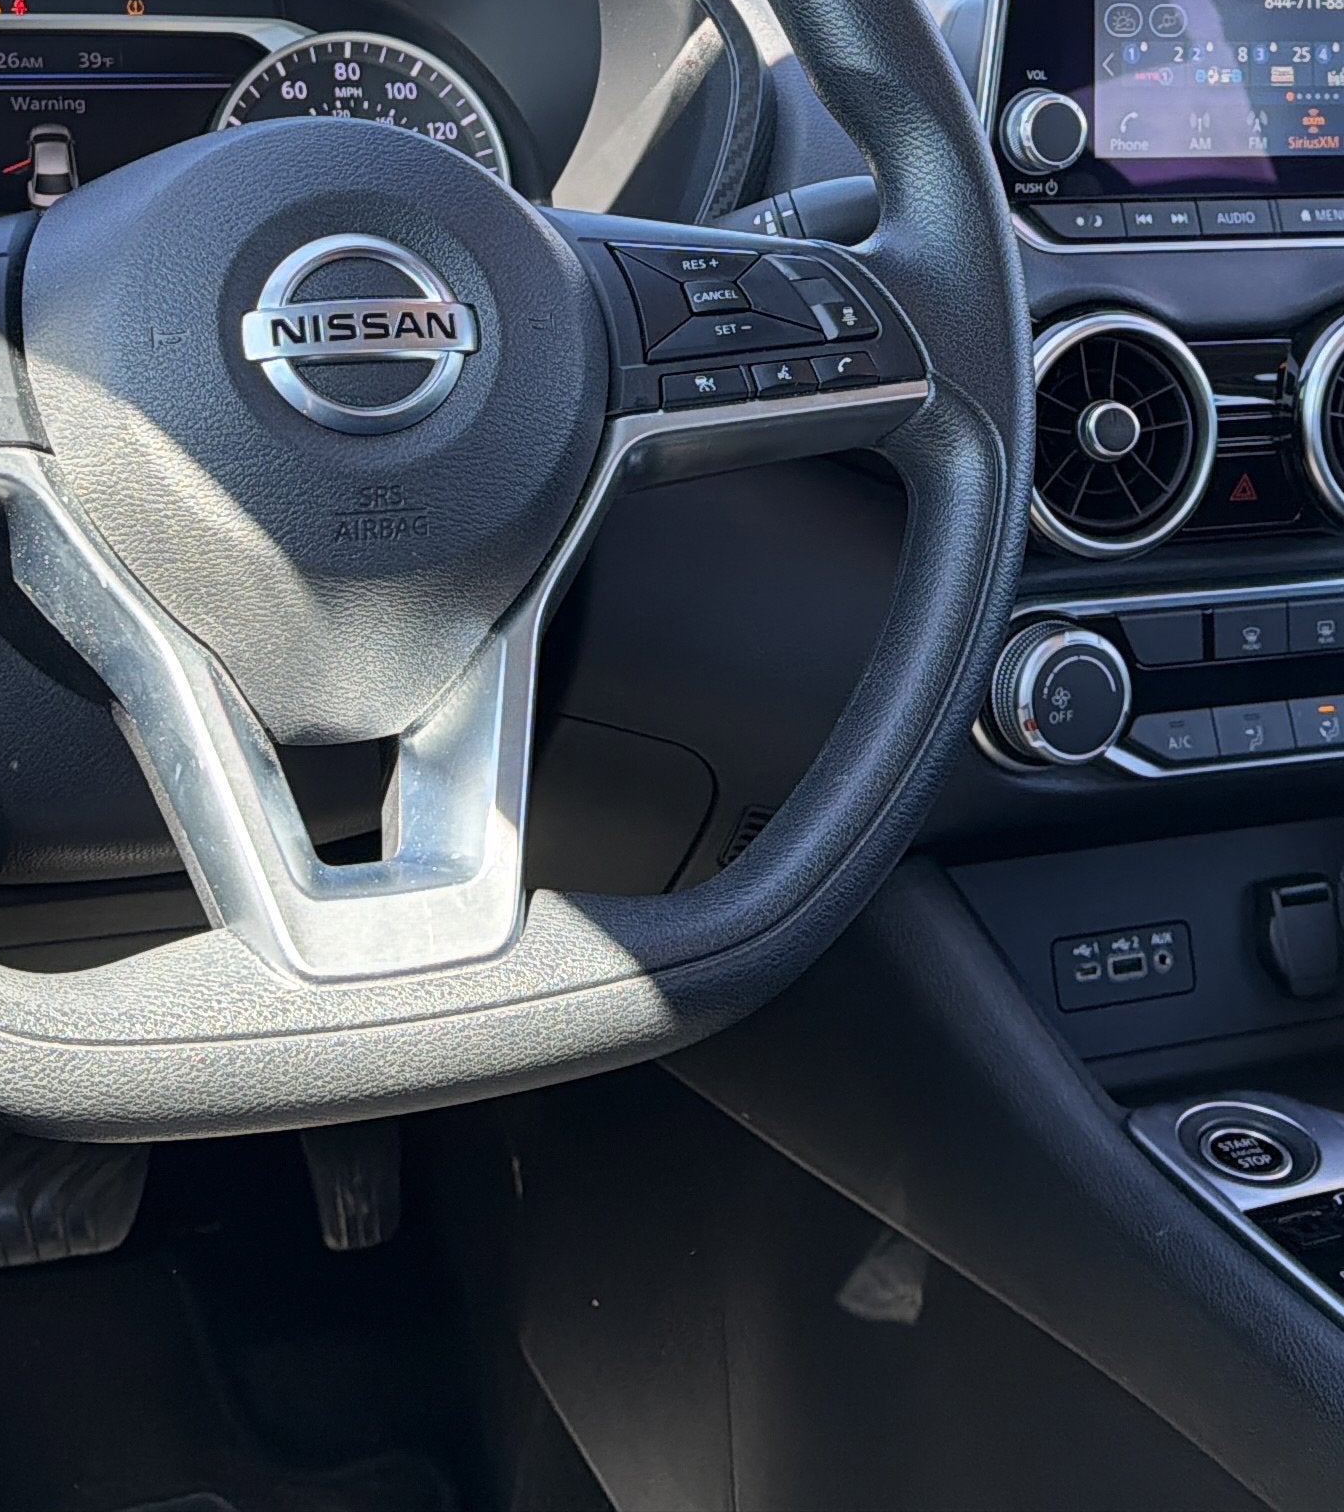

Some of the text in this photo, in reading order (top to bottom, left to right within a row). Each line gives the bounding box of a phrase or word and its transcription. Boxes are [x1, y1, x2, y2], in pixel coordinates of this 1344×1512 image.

[1173, 47, 1184, 62] 2
[1238, 47, 1248, 62] 8
[1292, 47, 1311, 63] 25
[334, 62, 361, 81] 80
[1026, 69, 1048, 81] VOL
[281, 80, 308, 100] 60
[335, 87, 363, 98] MPH
[384, 82, 418, 100] 100
[10, 95, 87, 114] Warning
[427, 121, 458, 141] 120
[1110, 139, 1150, 151] Phone
[1189, 139, 1212, 150] AM
[1248, 139, 1268, 150] FM
[1288, 137, 1340, 150] SiriusXM
[1014, 182, 1043, 194] PUSH
[1217, 212, 1256, 225] AUDIO
[682, 259, 706, 271] RES
[693, 290, 739, 303] CANCEL
[270, 310, 459, 348] NISSAN
[714, 324, 737, 336] SET
[359, 484, 404, 507] SRS
[1049, 710, 1074, 725] OFF
[1168, 735, 1193, 750] A/C
[1237, 1154, 1272, 1169] STOP
